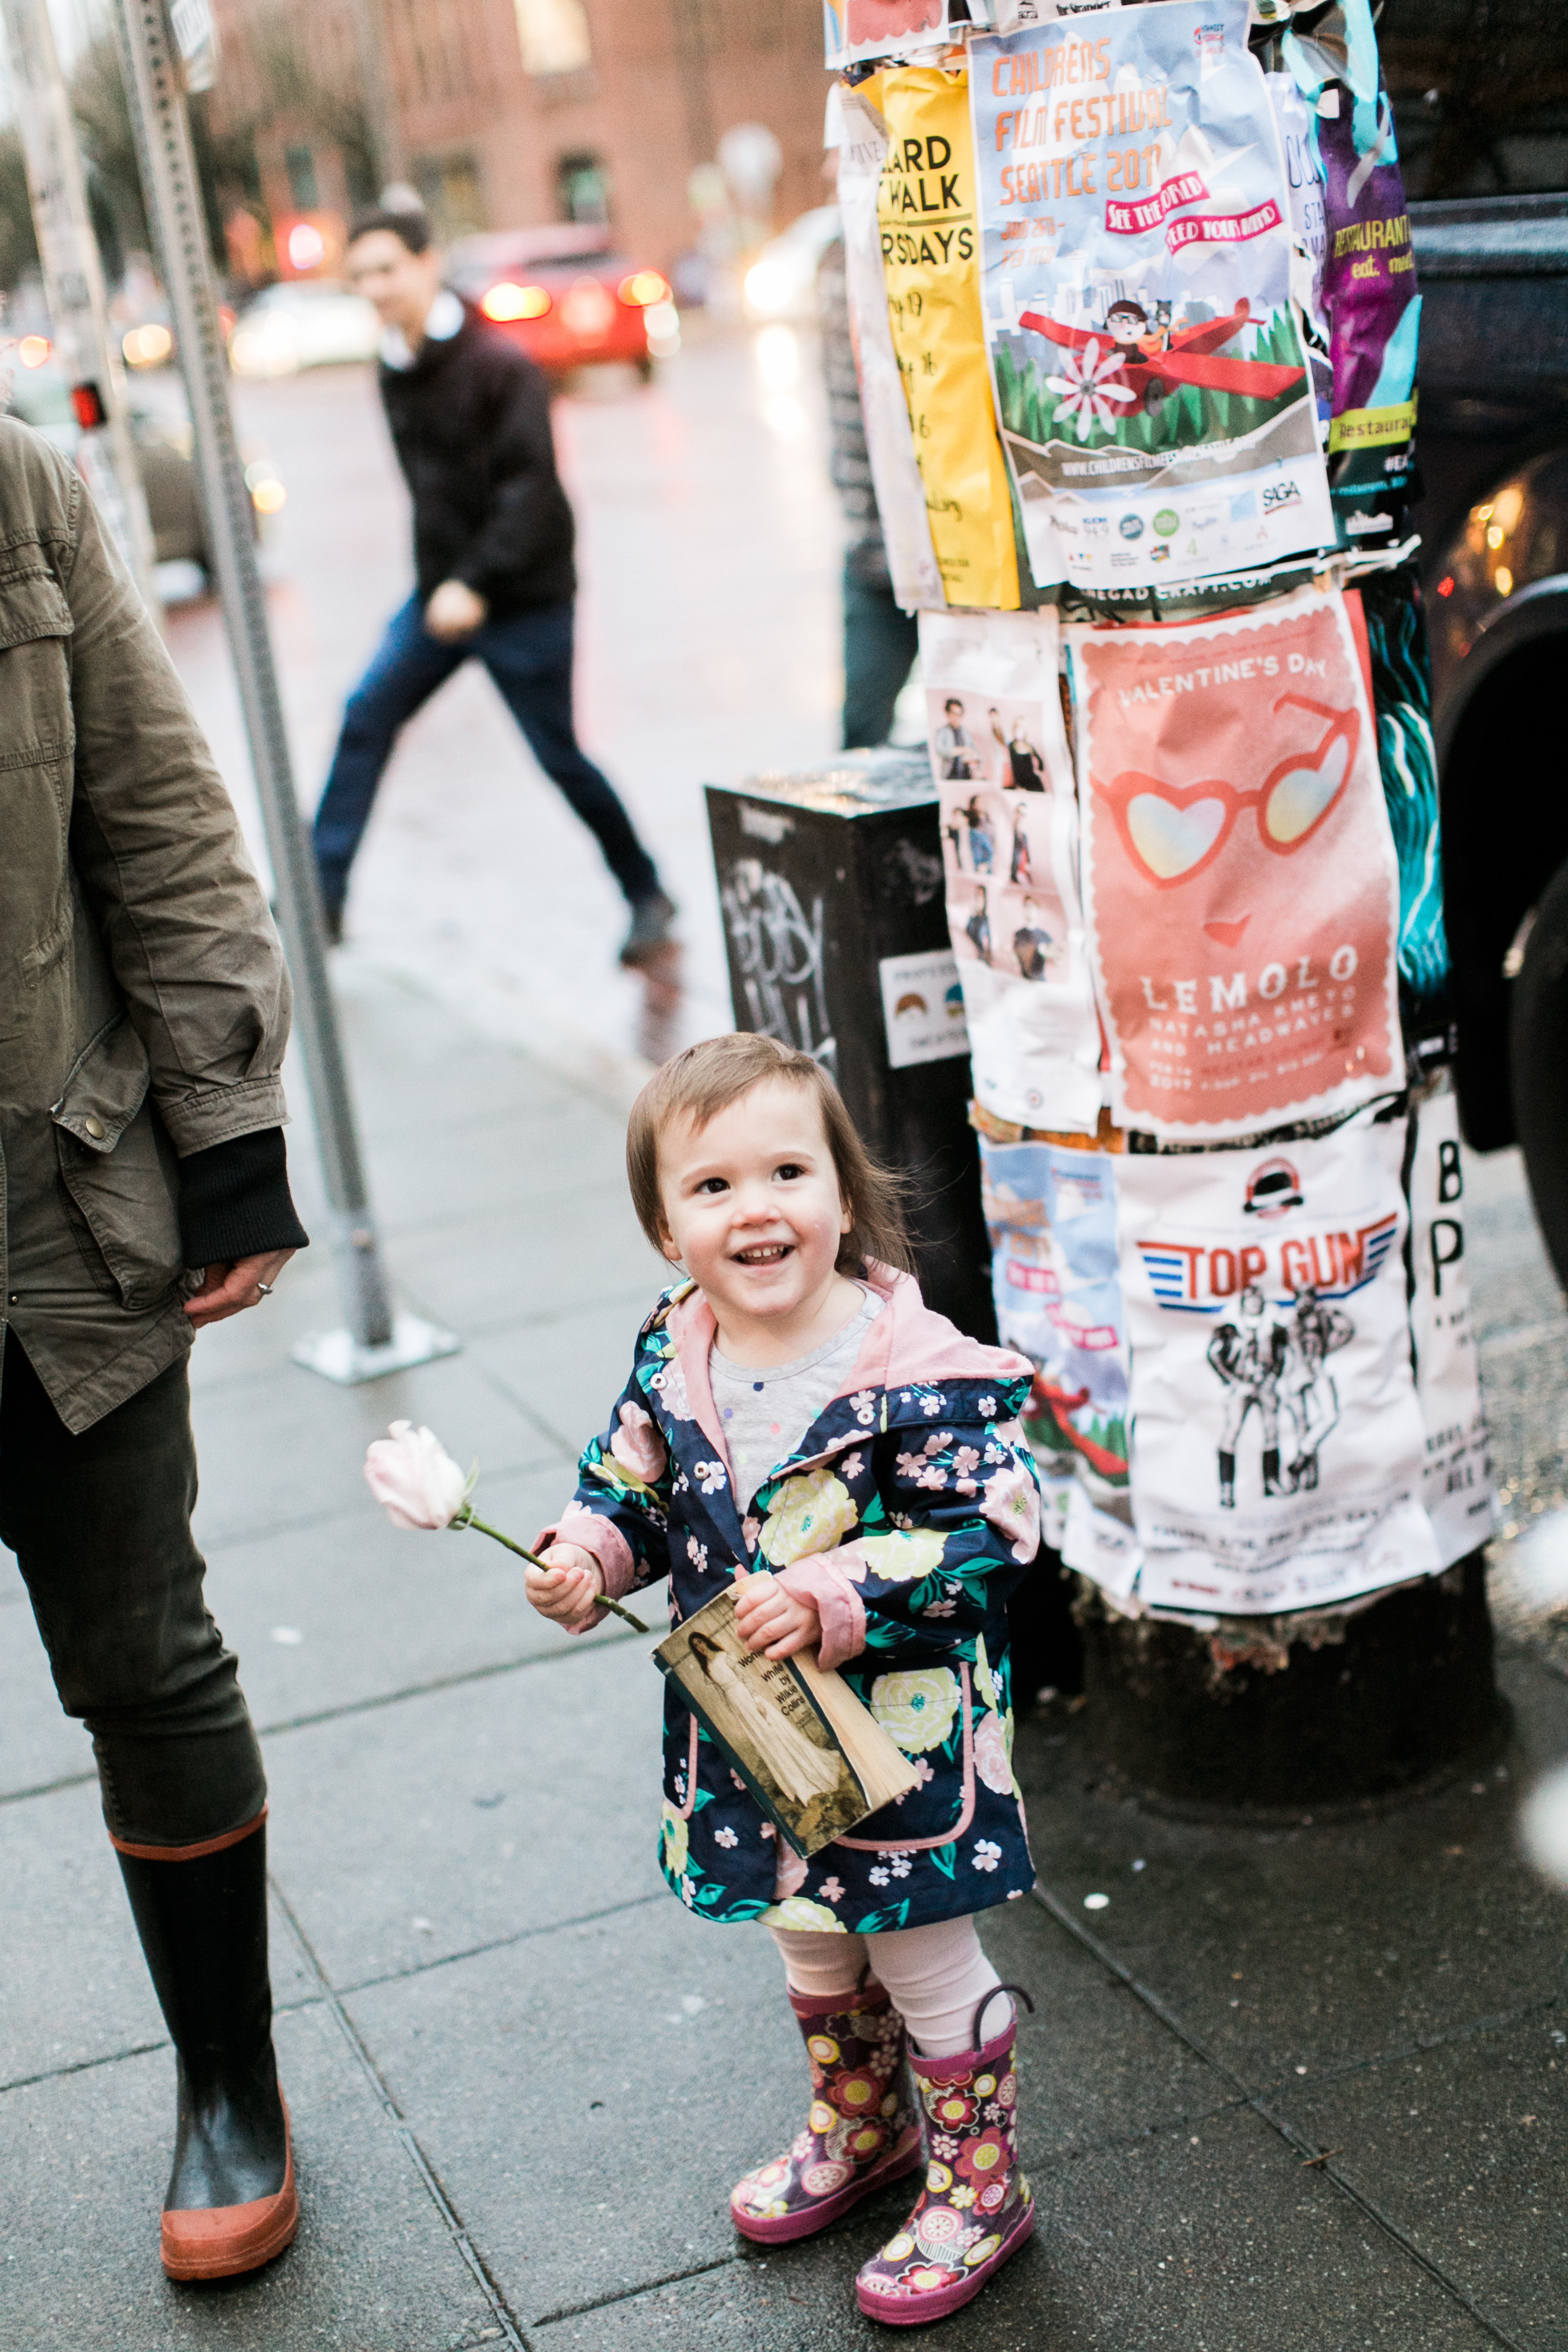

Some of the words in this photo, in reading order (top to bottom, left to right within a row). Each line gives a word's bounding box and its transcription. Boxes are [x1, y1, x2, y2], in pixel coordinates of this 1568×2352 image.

[995, 106, 1047, 151] FILM
[1054, 85, 1172, 142] FESTIVAL
[883, 136, 951, 173] ARD
[1000, 154, 1096, 205] SEATTLE
[890, 173, 962, 214] WALK
[1108, 204, 1132, 230] SEE
[1133, 200, 1163, 227] THE
[1160, 176, 1202, 209] ORLD
[1118, 655, 1279, 707] VALENTINE'S
[1288, 653, 1327, 678] DAY
[1140, 945, 1357, 1015] LEMOLO
[1439, 1140, 1463, 1204] B
[1146, 1241, 1267, 1299] TOP
[1281, 1219, 1387, 1293] GUN
[1431, 1219, 1464, 1297] P
[761, 1664, 783, 1682] White
[775, 1685, 798, 1704] Wilkie
[779, 1674, 791, 1685] by
[781, 1696, 805, 1716] Collins
